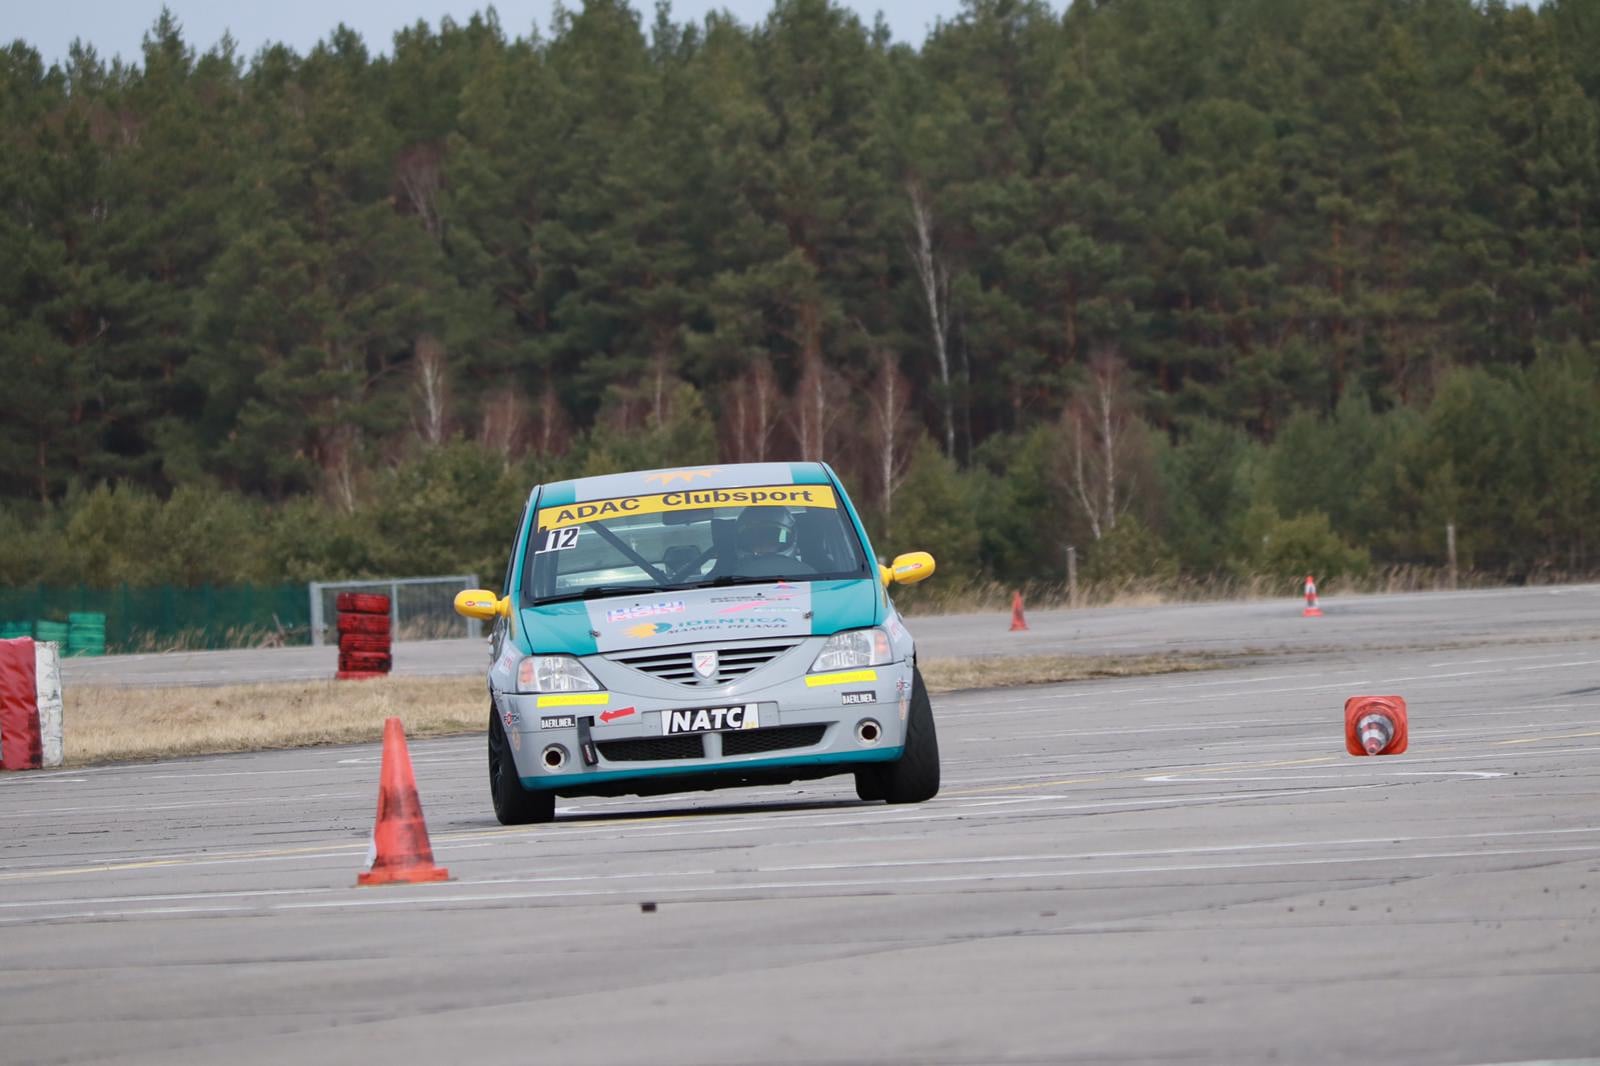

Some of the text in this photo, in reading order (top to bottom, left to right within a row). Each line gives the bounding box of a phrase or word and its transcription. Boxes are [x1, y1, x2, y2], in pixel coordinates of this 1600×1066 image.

[555, 490, 814, 523] ADAC Clubsport
[551, 528, 578, 549] 12
[671, 707, 743, 732] NATC
